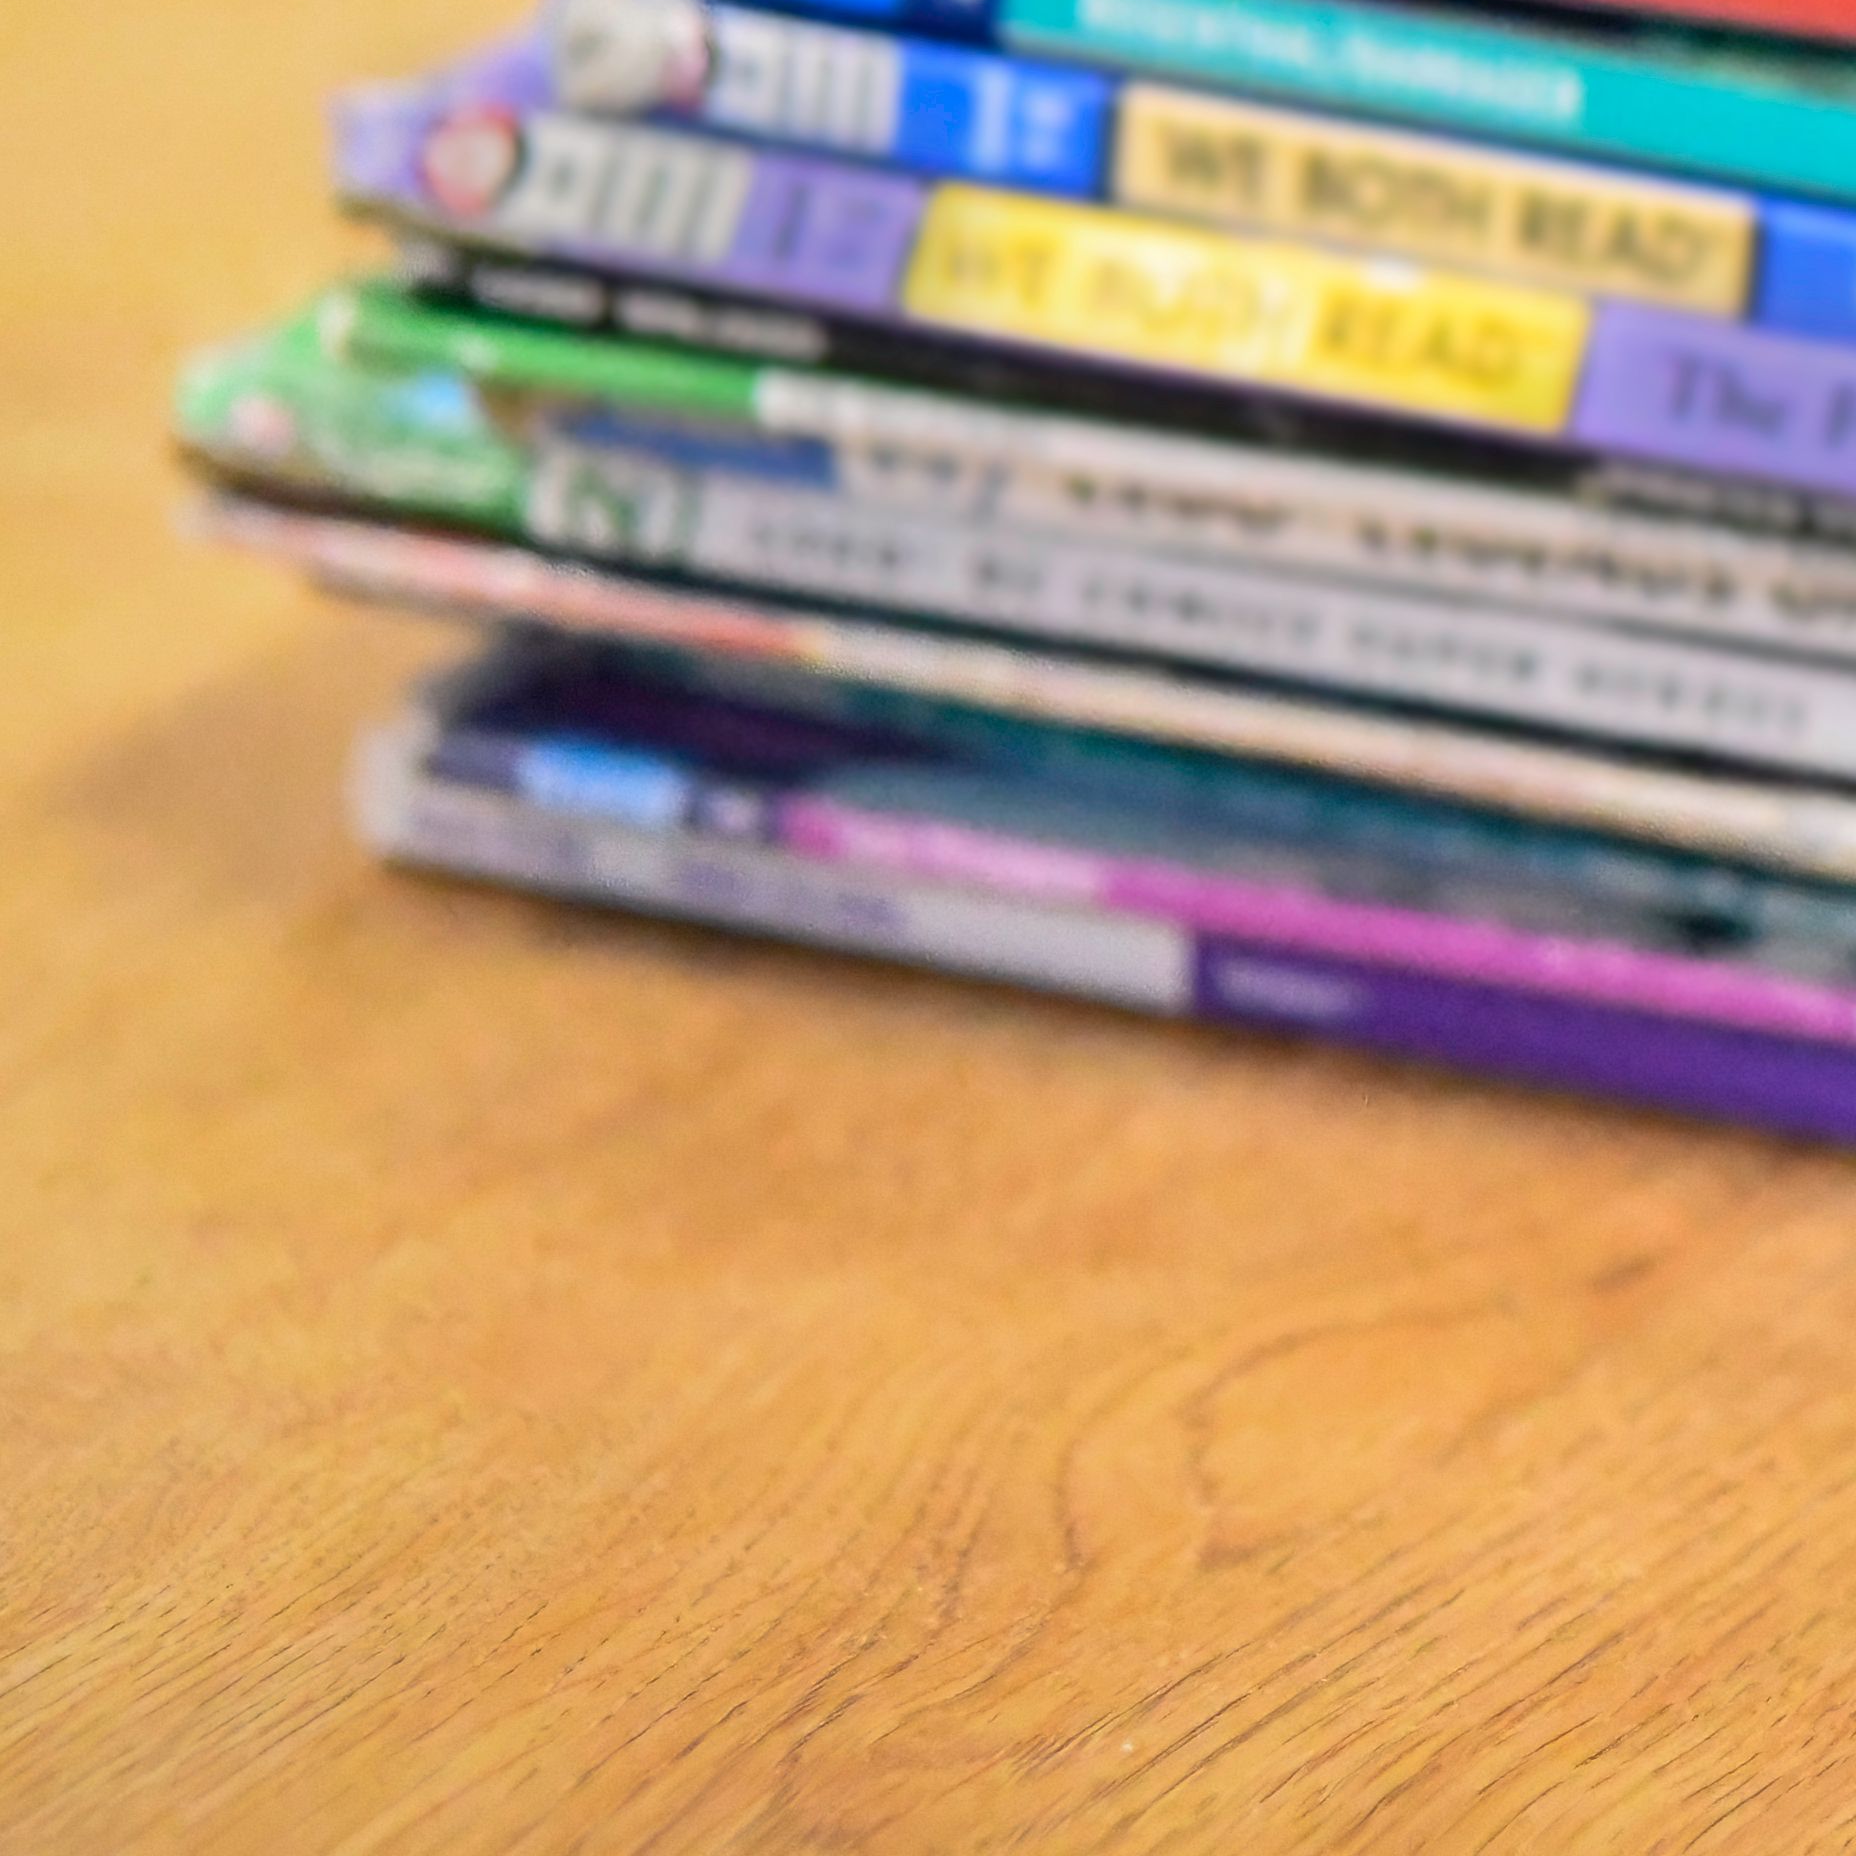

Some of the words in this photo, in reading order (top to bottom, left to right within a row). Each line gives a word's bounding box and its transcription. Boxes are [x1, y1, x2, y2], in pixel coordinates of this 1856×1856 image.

[1163, 119, 1268, 196] WE
[1296, 144, 1496, 236] BOTH
[941, 232, 1061, 308] WE
[1662, 351, 1789, 440] The
